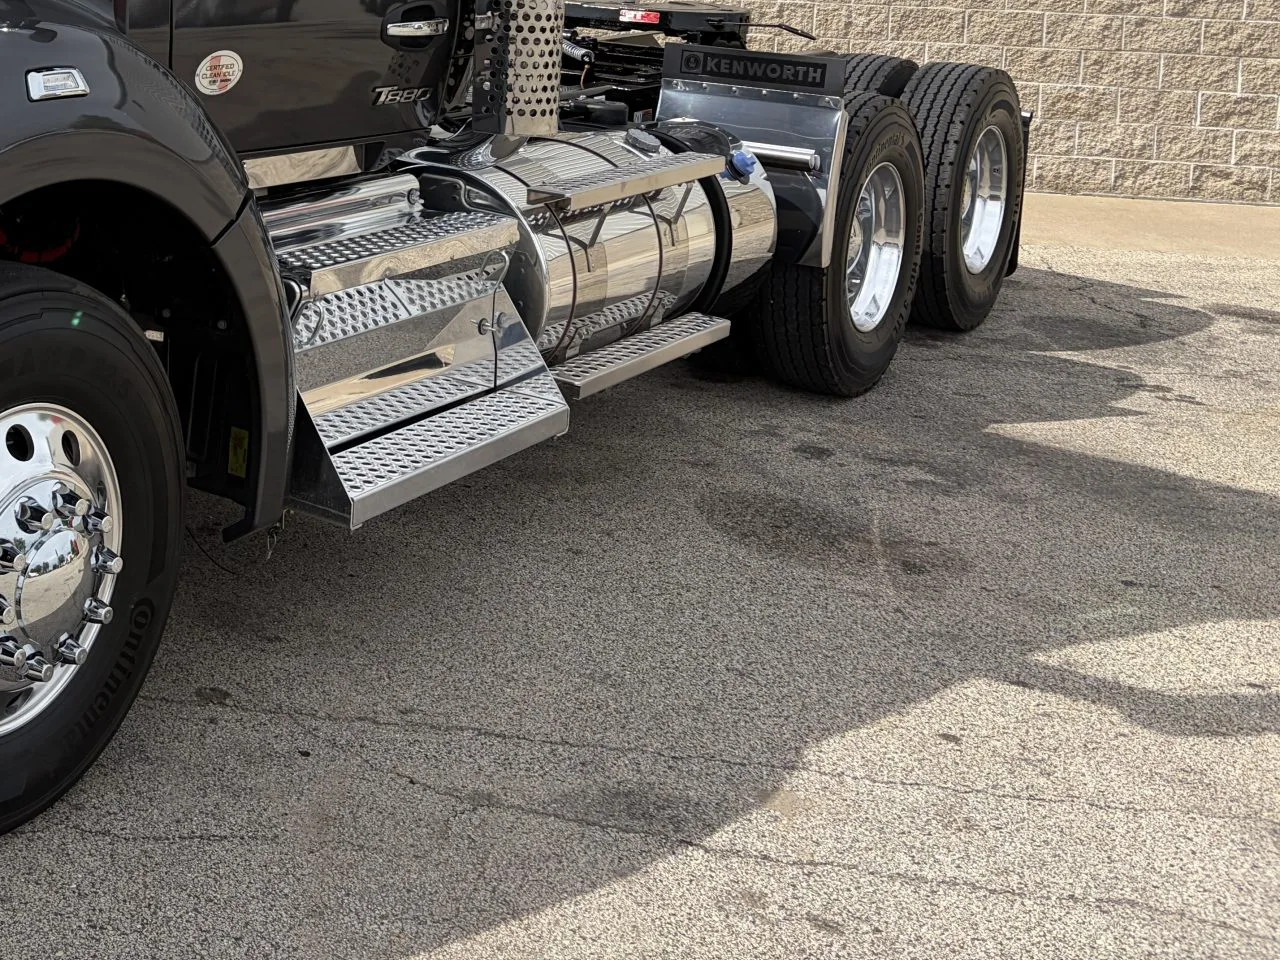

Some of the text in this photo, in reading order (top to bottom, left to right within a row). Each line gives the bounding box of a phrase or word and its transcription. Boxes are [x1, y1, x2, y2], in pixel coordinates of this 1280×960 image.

[201, 71, 222, 80] CLEAN
[706, 55, 823, 83] KENWORTH
[375, 86, 432, 106] T880
